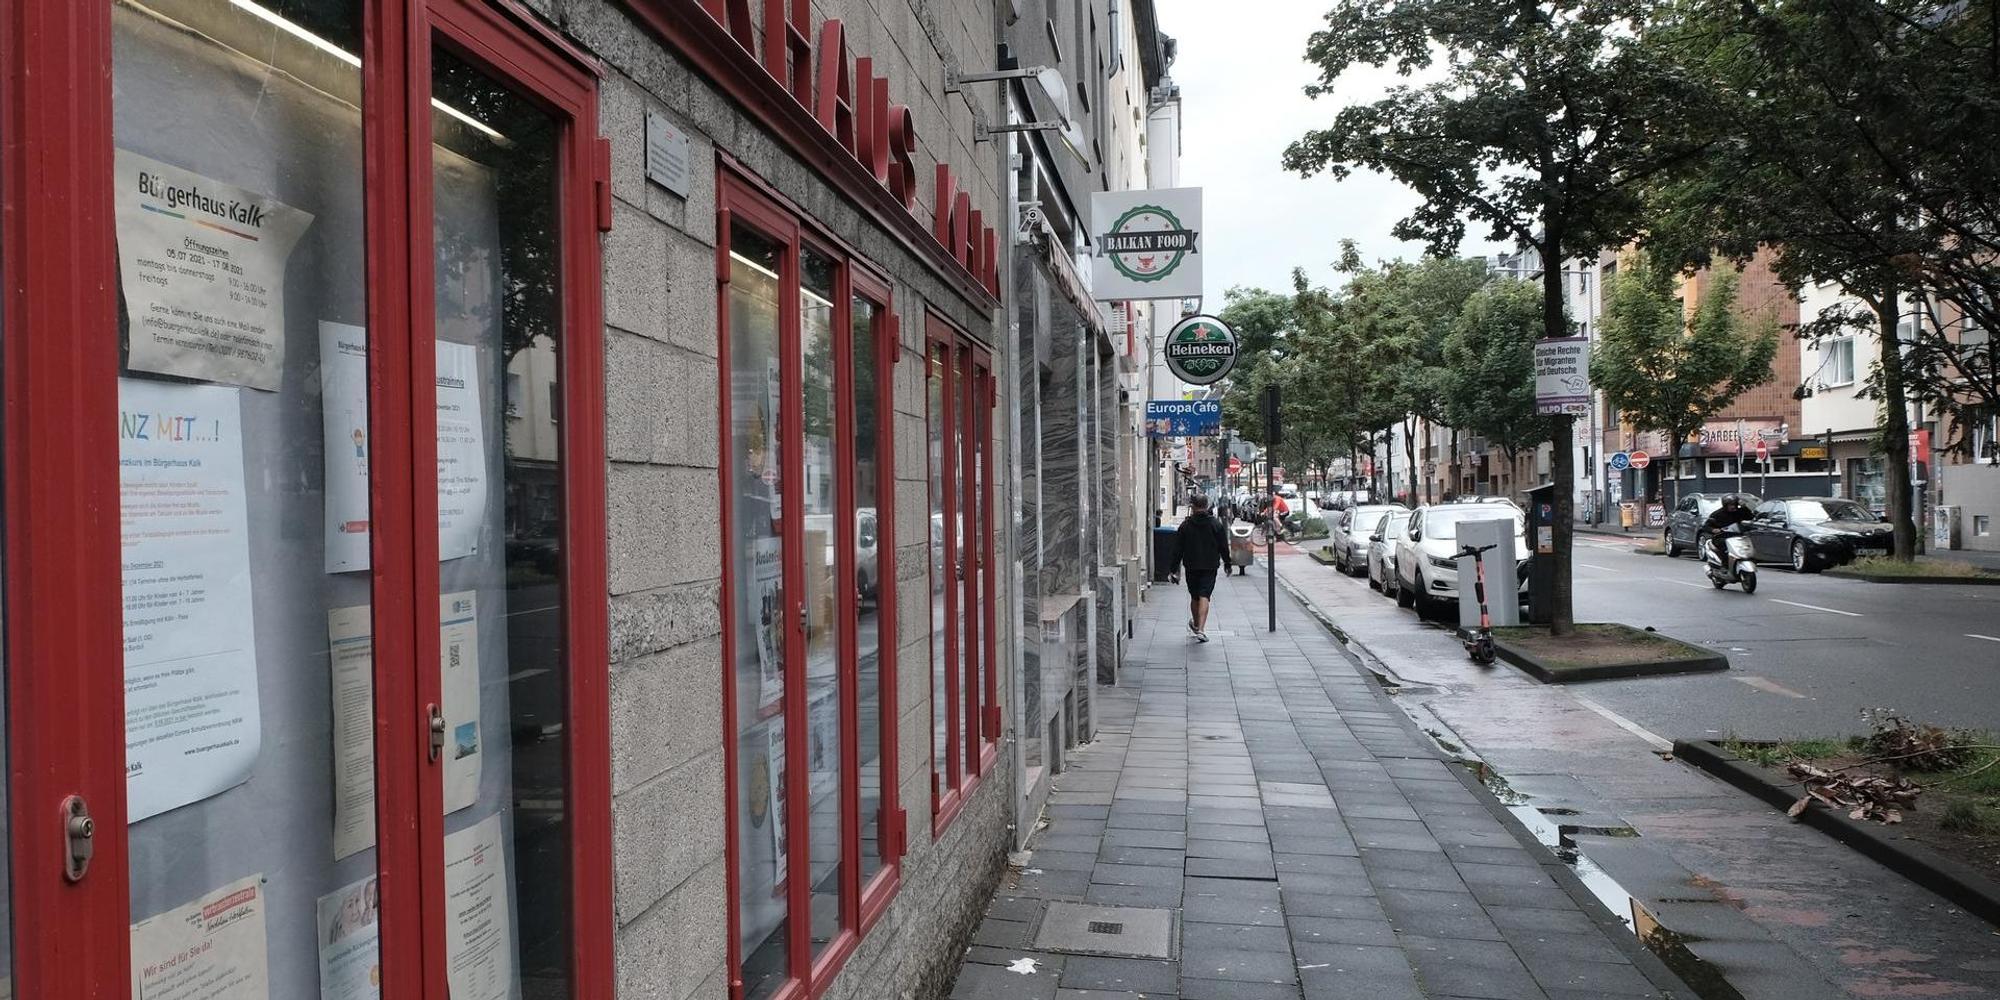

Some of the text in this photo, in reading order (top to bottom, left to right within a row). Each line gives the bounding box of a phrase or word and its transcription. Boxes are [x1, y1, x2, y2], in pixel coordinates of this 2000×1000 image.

[1107, 234, 1187, 251] BALKAN FOOD
[150, 302, 170, 314] Gerne
[193, 311, 203, 321] Sie
[152, 333, 174, 345] Termin
[1171, 343, 1232, 356] Heineken
[1536, 345, 1581, 357] Gleiche Rechte
[1544, 356, 1577, 367] Migranten
[1536, 366, 1577, 377] und Deutsche
[121, 411, 149, 441] NZ
[120, 459, 142, 467] nzkurs
[143, 966, 155, 978] Wir
[159, 956, 177, 972] sind
[178, 951, 189, 964] für
[189, 944, 200, 958] Sie
